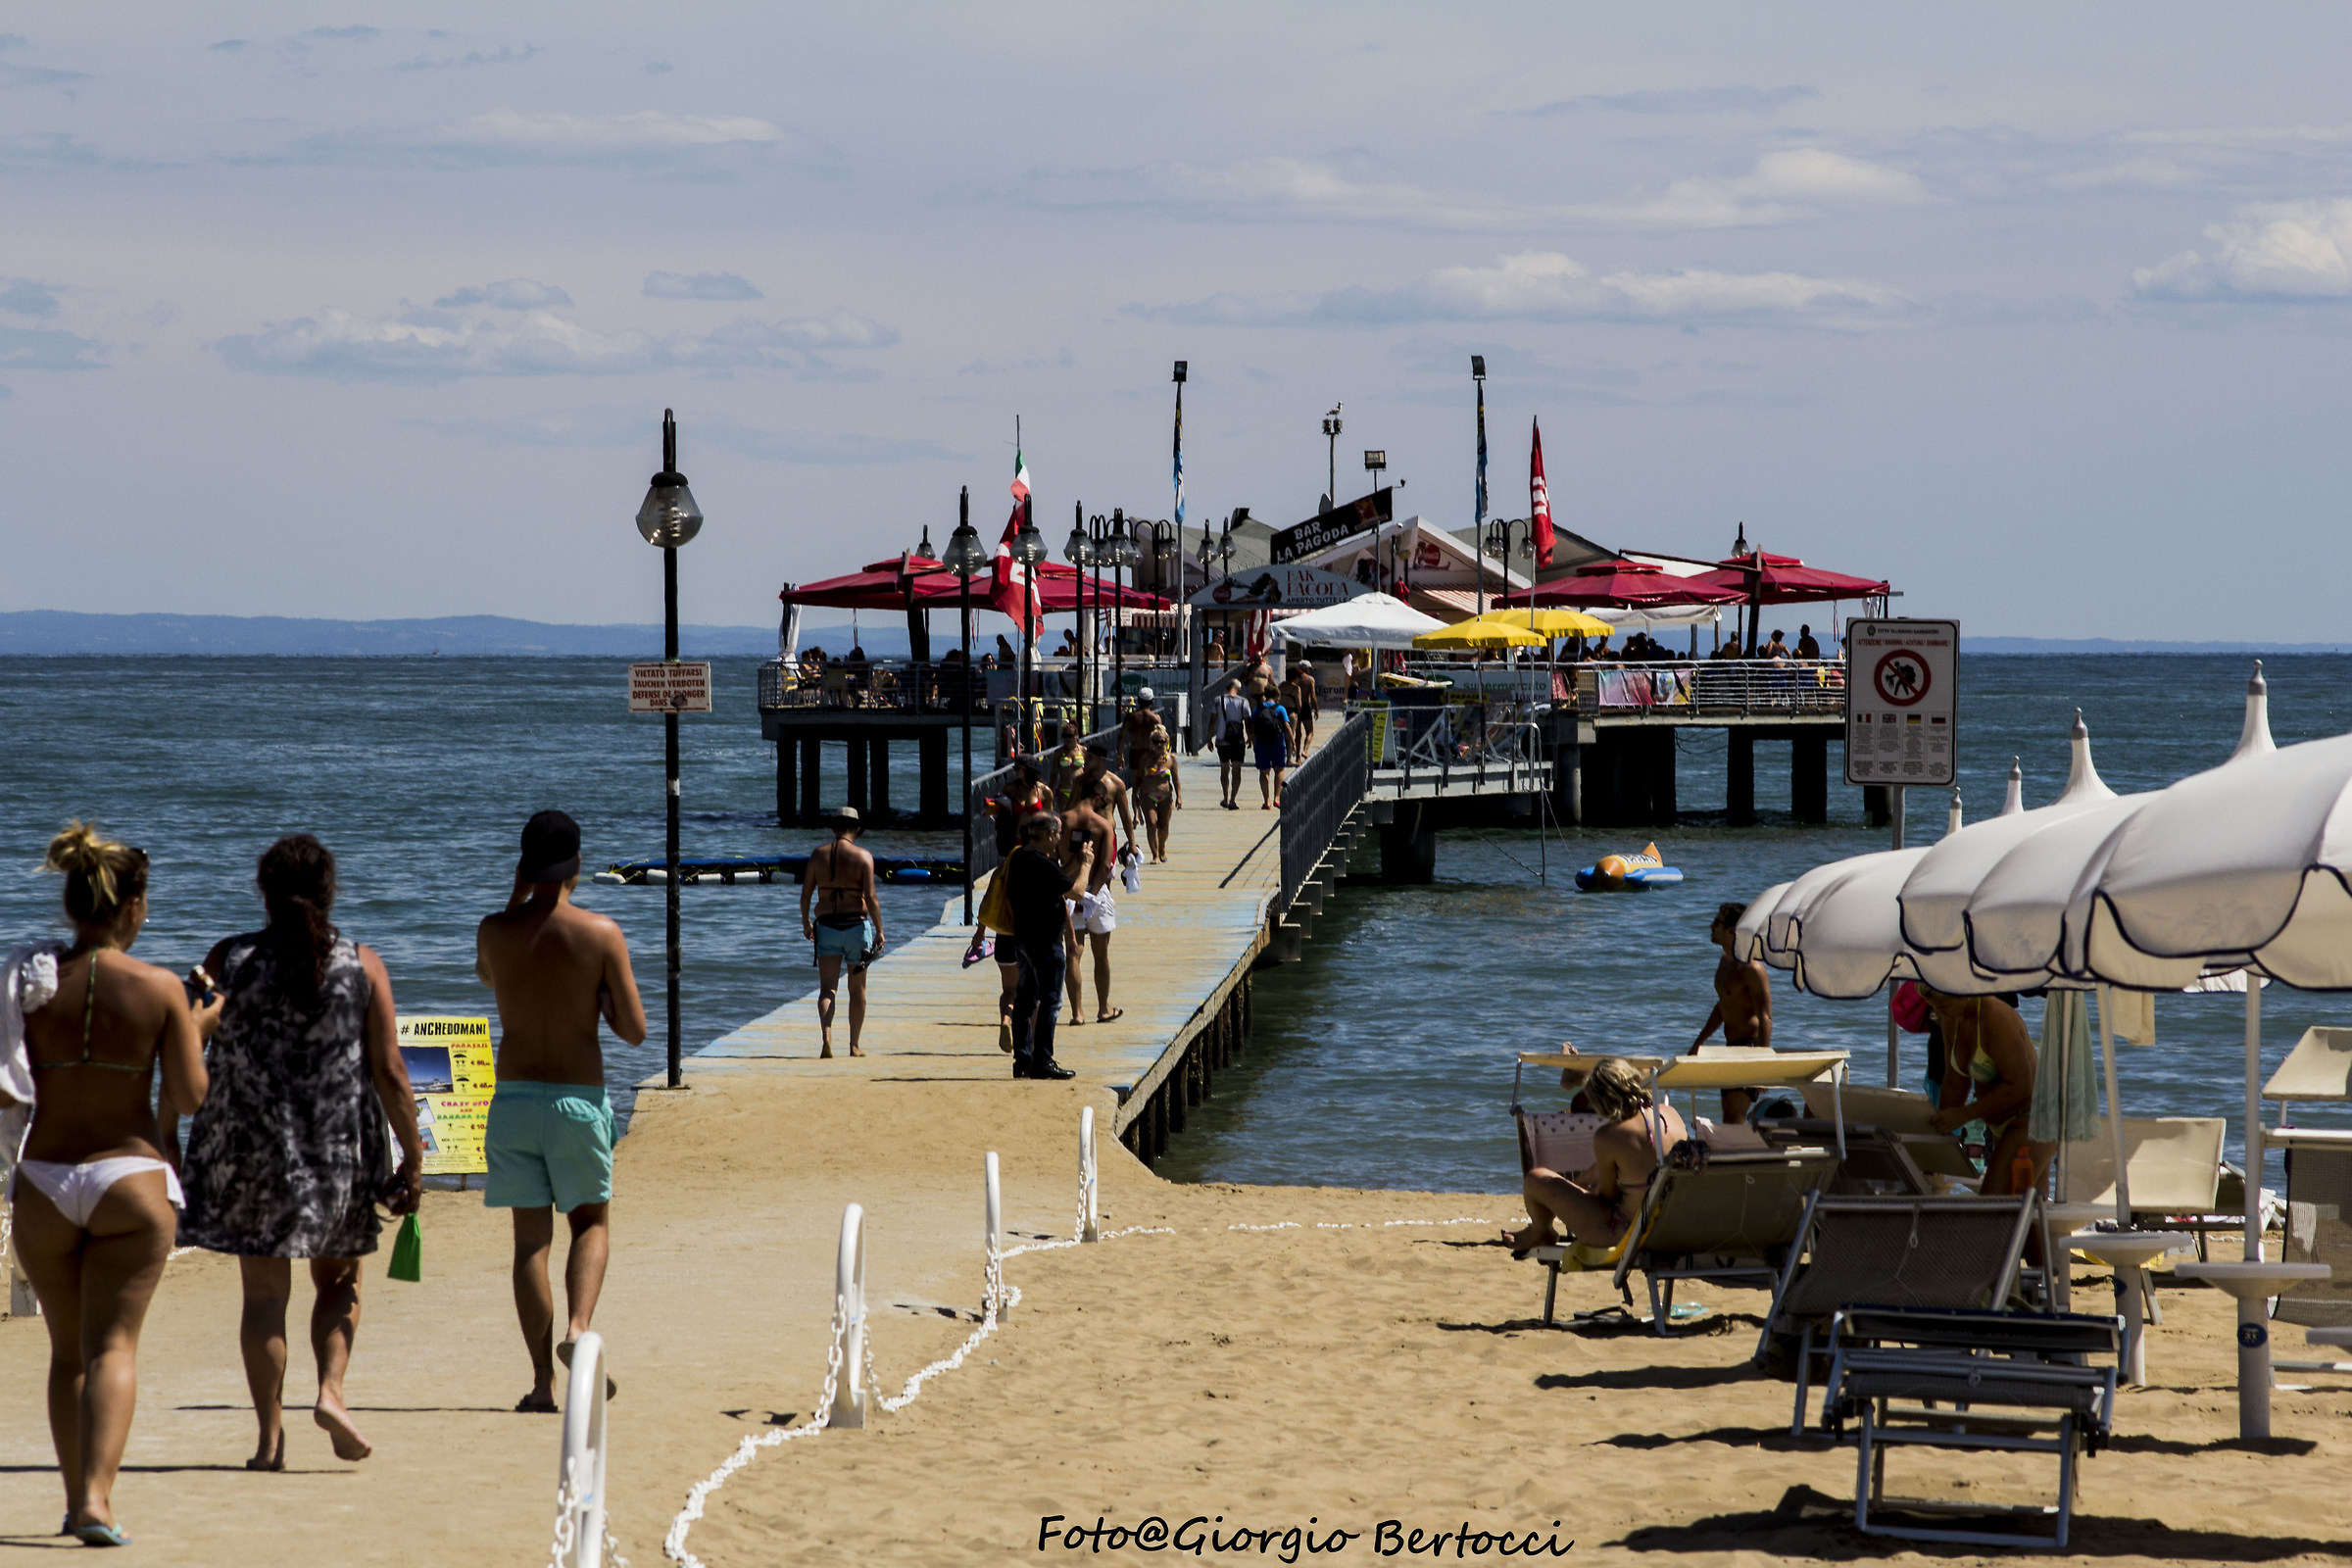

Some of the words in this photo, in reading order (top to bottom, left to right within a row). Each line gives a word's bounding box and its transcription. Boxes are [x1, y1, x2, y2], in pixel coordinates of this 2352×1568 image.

[1294, 521, 1322, 540] BAR
[1277, 547, 1293, 563] LA
[1296, 524, 1349, 555] PAGODA
[635, 669, 665, 678] VIETATO
[668, 667, 704, 677] TUFFARSI
[667, 679, 706, 688] VERBOTEN
[632, 690, 661, 700] DEFENSE
[662, 690, 671, 699] DE
[651, 698, 668, 707] DANS
[415, 1022, 486, 1036] ANCHEDOMANI
